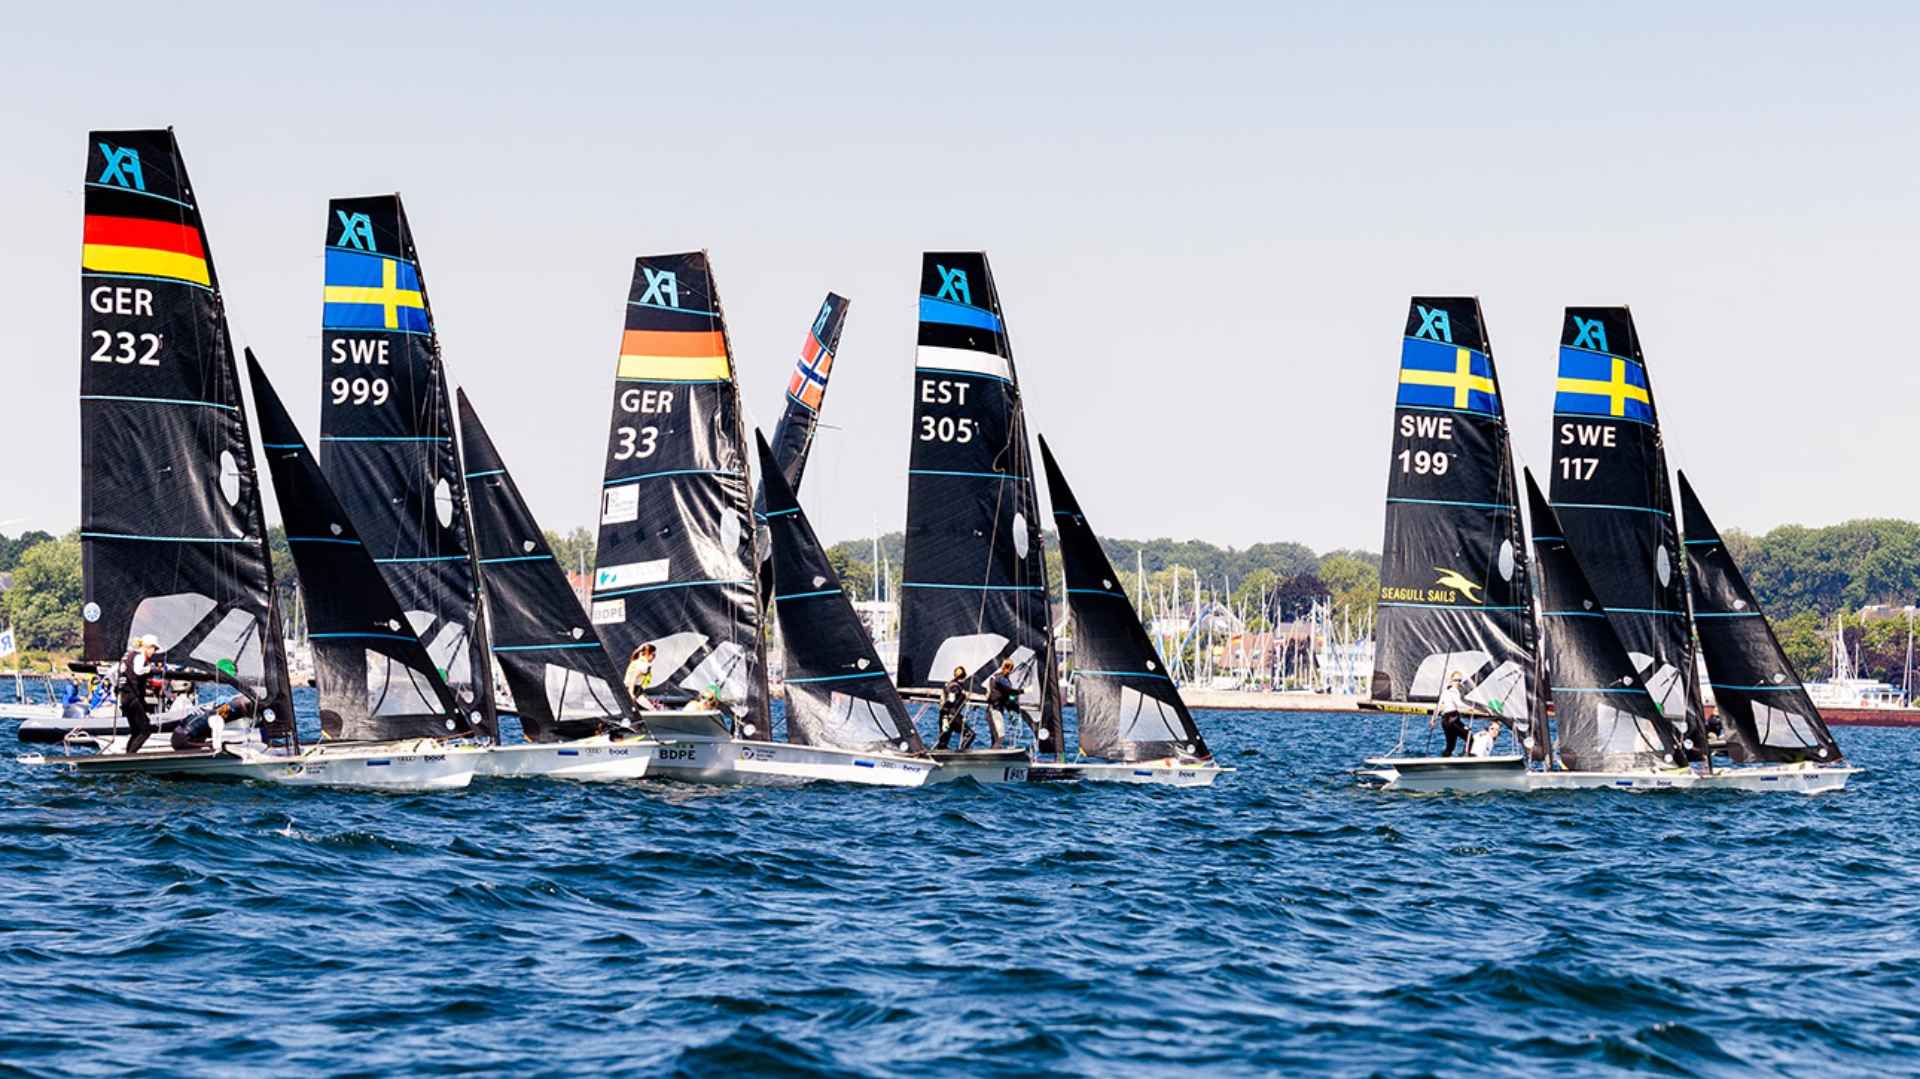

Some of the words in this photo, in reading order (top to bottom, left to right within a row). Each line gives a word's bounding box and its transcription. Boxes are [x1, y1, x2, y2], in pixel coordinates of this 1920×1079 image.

[90, 286, 153, 317] GER
[90, 329, 161, 366] 232
[331, 338, 390, 366] SWE
[330, 377, 389, 406] 999
[619, 388, 674, 414] GER
[921, 379, 970, 406] EST
[919, 415, 973, 444] 305
[1400, 414, 1453, 441] SWE
[1560, 423, 1617, 448] SWE
[613, 426, 659, 461] 33
[1398, 449, 1449, 476] 199
[1559, 457, 1600, 481] 117
[1381, 586, 1425, 602] SEAGULL
[1427, 588, 1456, 603] SAILS
[594, 607, 624, 620] BDPE
[424, 754, 446, 762] boot
[659, 749, 697, 761] BDPE
